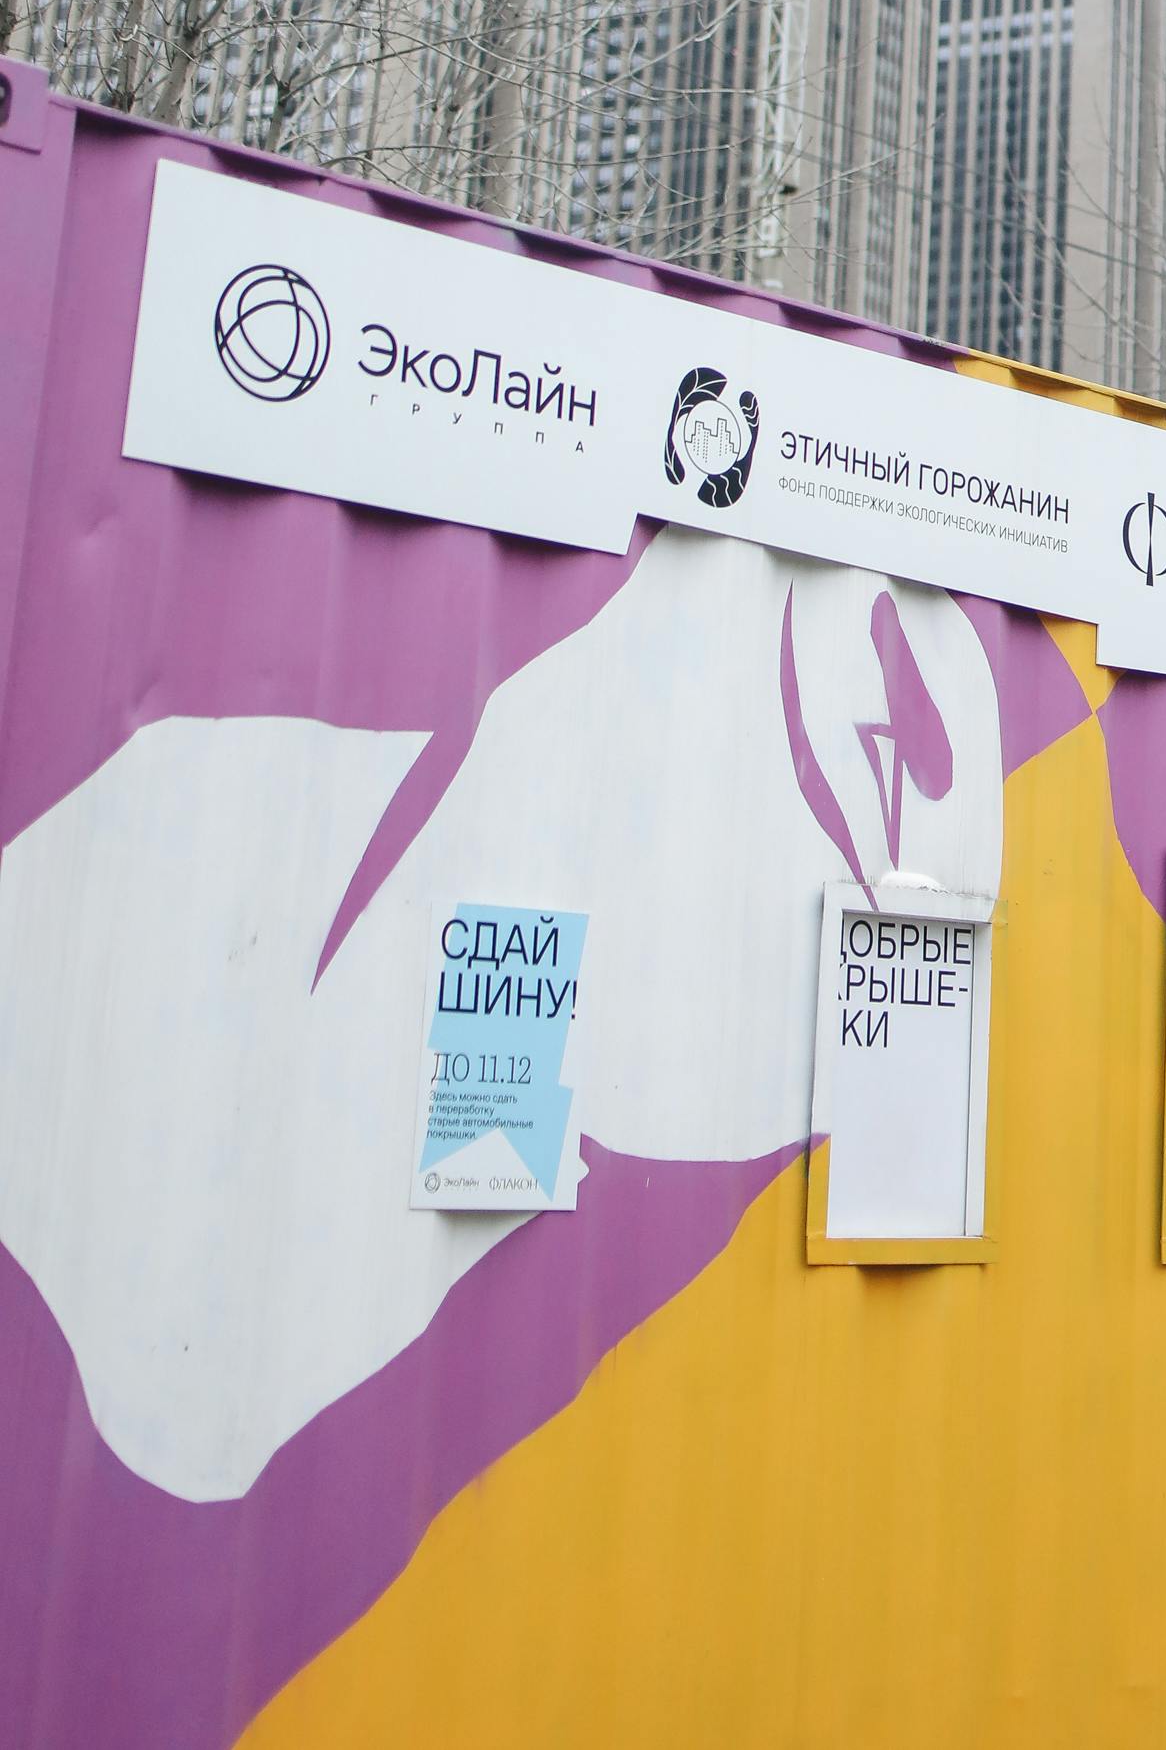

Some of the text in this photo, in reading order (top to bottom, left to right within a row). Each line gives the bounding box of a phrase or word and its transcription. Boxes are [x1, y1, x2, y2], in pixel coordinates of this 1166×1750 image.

[357, 323, 597, 427] ЭкоЛайн
[370, 394, 585, 453] ГРУППА
[780, 431, 1069, 524] ЭТИЧНЫЙ ГОРОЖАНИН
[778, 476, 1068, 553] ФОНД ПОДДЕРЖКИ ЭКОЛОГИЧЕСКИХ ИНИЦИАТИВ
[441, 915, 560, 971] СДАЙ
[437, 970, 579, 1020] ШИНУ!
[842, 1008, 888, 1048] КИ
[430, 1051, 532, 1087] ДО 11.12
[428, 1104, 495, 1117] в переработку
[429, 1090, 518, 1105] Здесь можно сдать
[427, 1117, 534, 1129] старые автомобильные
[489, 1175, 539, 1191] ФЛАКОН
